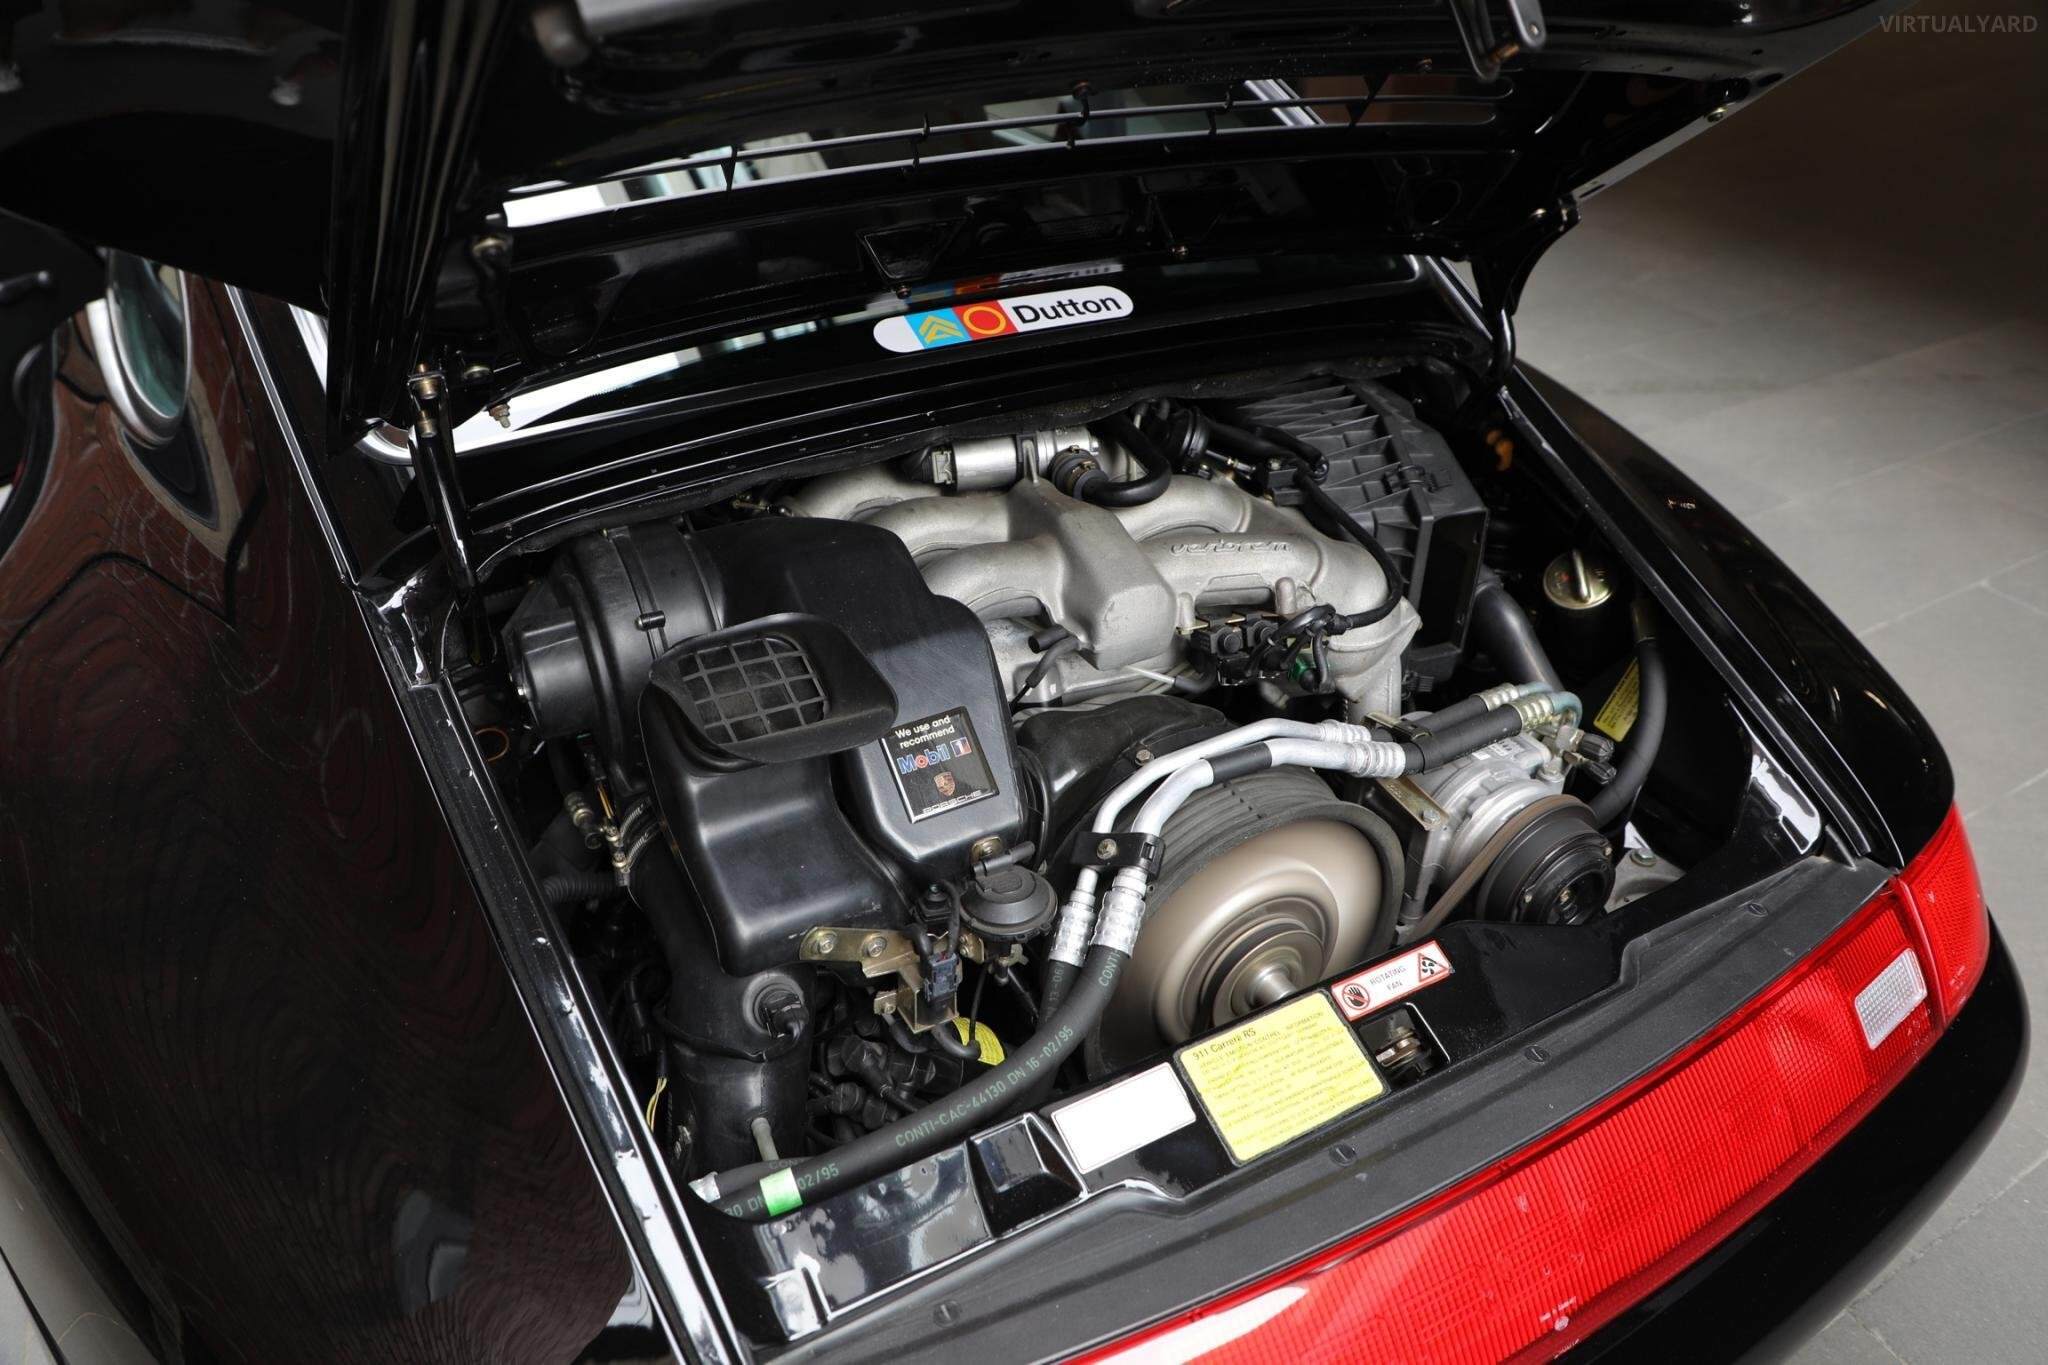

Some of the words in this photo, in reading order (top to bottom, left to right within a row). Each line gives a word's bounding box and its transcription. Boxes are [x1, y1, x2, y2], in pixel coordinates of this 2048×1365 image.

[1012, 296, 1123, 325] Dutton
[895, 728, 912, 739] We
[913, 722, 931, 734] use
[932, 714, 952, 728] and
[899, 725, 956, 749] recommend
[897, 743, 952, 775] Mobil
[1192, 1047, 1209, 1060] 911
[1210, 1034, 1243, 1054] Carrera
[1243, 1027, 1257, 1039] RS
[1006, 1066, 1027, 1086] DN
